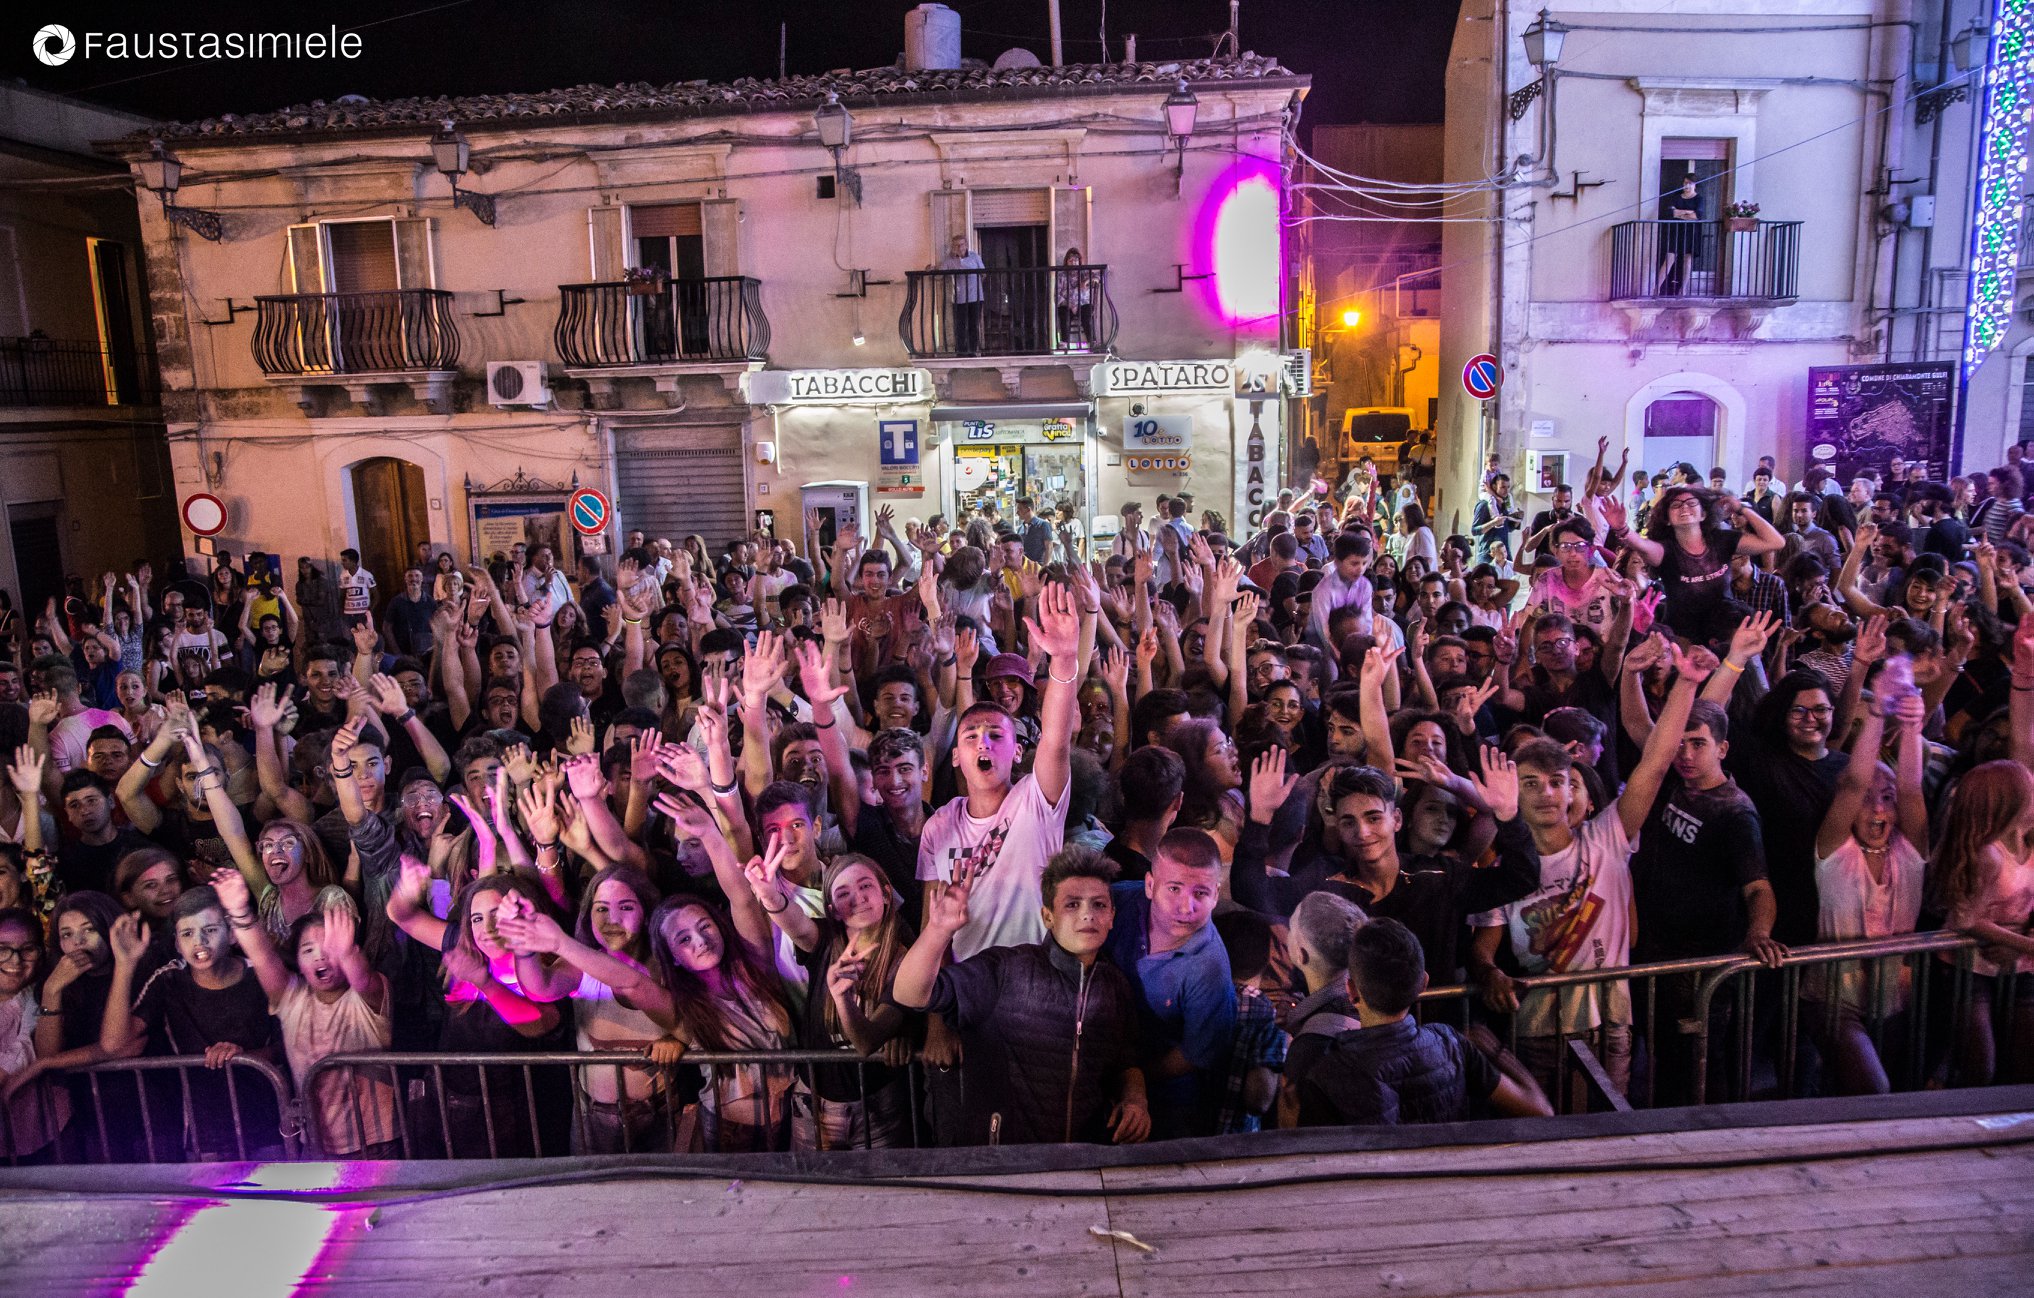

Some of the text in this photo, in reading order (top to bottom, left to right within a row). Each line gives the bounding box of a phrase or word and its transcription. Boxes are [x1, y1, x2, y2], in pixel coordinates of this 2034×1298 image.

[1112, 364, 1229, 386] SPATARO
[1861, 374, 1885, 382] COMUNE
[1892, 372, 1931, 380] CHIARAMONTE
[791, 373, 917, 396] TABACCHI
[1134, 420, 1158, 437] 10
[884, 424, 914, 459] T
[1142, 435, 1182, 445] LOTTO
[1128, 457, 1189, 470] LOTTO
[1691, 575, 1704, 583] ARE
[1661, 804, 1703, 844] ANS
